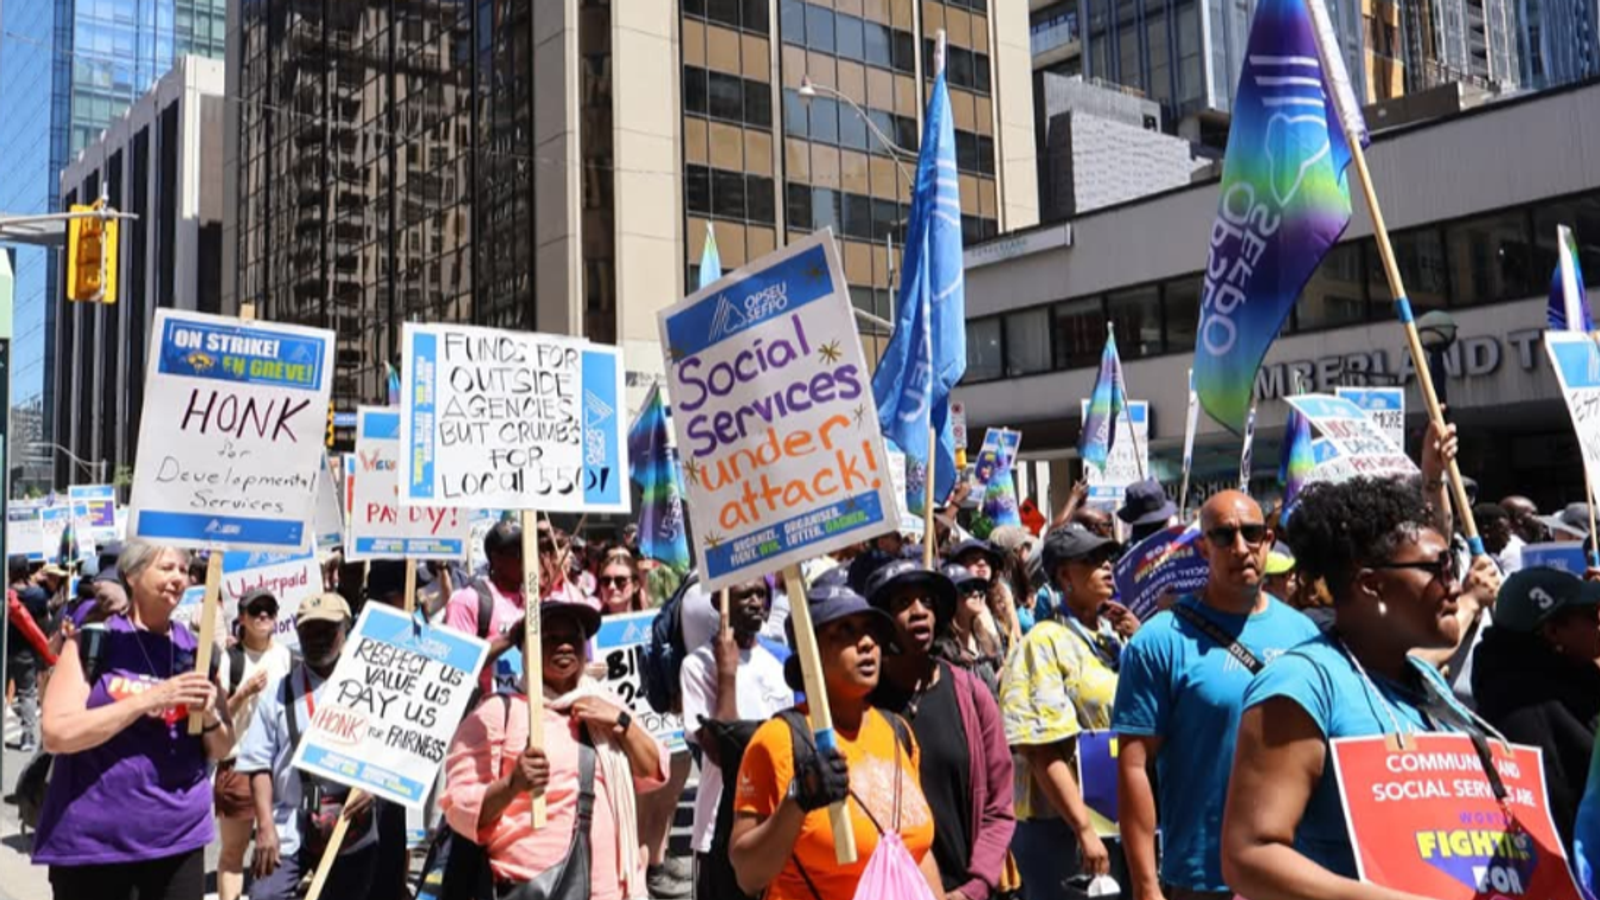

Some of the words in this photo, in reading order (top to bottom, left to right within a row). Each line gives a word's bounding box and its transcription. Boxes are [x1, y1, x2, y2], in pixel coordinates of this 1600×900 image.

[744, 282, 786, 311] OPSEU
[746, 295, 787, 322] SEFPO
[174, 329, 203, 349] ON
[207, 333, 280, 358] STRIKE!
[536, 343, 579, 369] FOR
[678, 314, 810, 412] Social
[1254, 336, 1500, 399] MBERLND
[450, 366, 573, 398] OUTSIDE
[181, 388, 310, 442] HONK
[439, 421, 490, 446] BUT
[498, 419, 580, 445] CRUMBS
[218, 438, 251, 458] for
[489, 446, 544, 469] FOR
[701, 414, 850, 491] under
[156, 456, 316, 492] Developmental
[719, 440, 882, 530] attack!
[190, 489, 284, 512] Services
[408, 506, 457, 535] DAY!
[1529, 587, 1554, 610] 3
[354, 637, 430, 676] RESPECT
[440, 665, 464, 686] US
[366, 666, 418, 696] VALUE
[424, 682, 451, 706] US
[337, 679, 398, 719] PAY
[404, 702, 437, 728] US
[317, 708, 365, 743] HONK
[385, 725, 446, 764] FAIRNESS
[1372, 779, 1450, 801] SOCIAL
[1472, 865, 1524, 894] FOR
